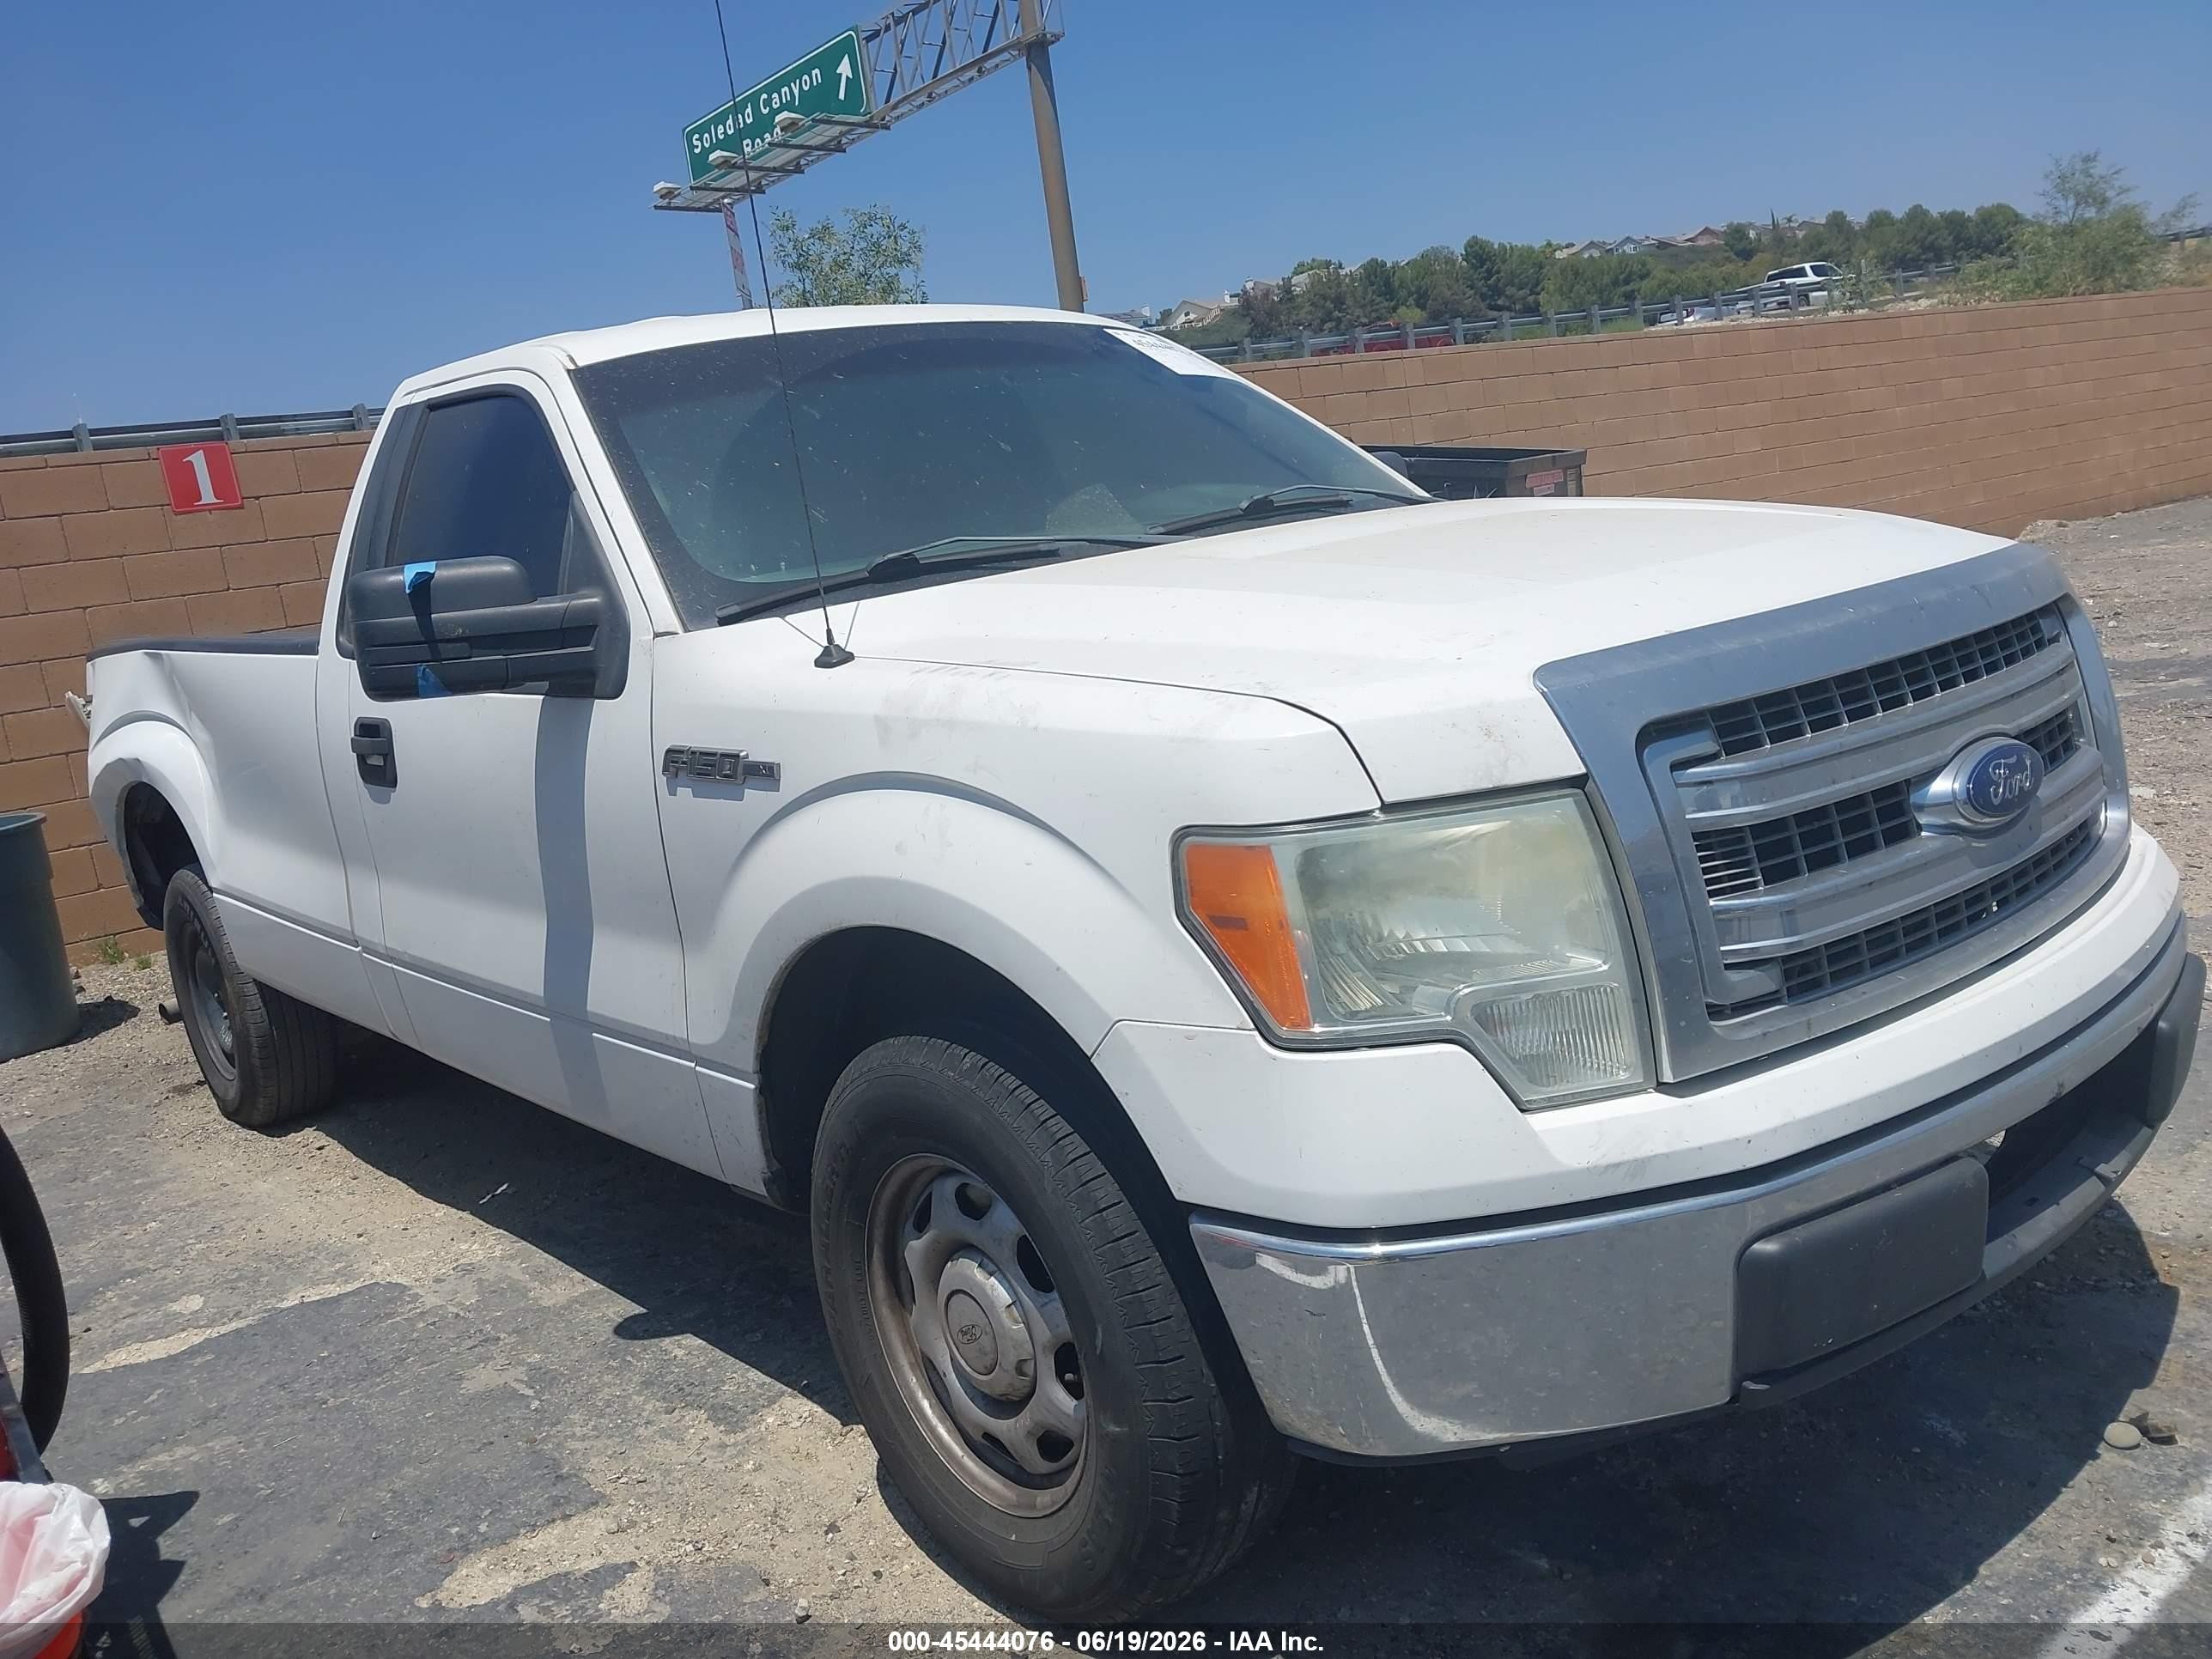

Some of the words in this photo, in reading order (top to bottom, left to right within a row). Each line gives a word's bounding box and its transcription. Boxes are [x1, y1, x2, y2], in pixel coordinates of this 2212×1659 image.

[692, 102, 753, 154] Soledad
[760, 68, 822, 114] Canyon
[182, 449, 224, 506] 1
[1989, 752, 2034, 805] Ford
